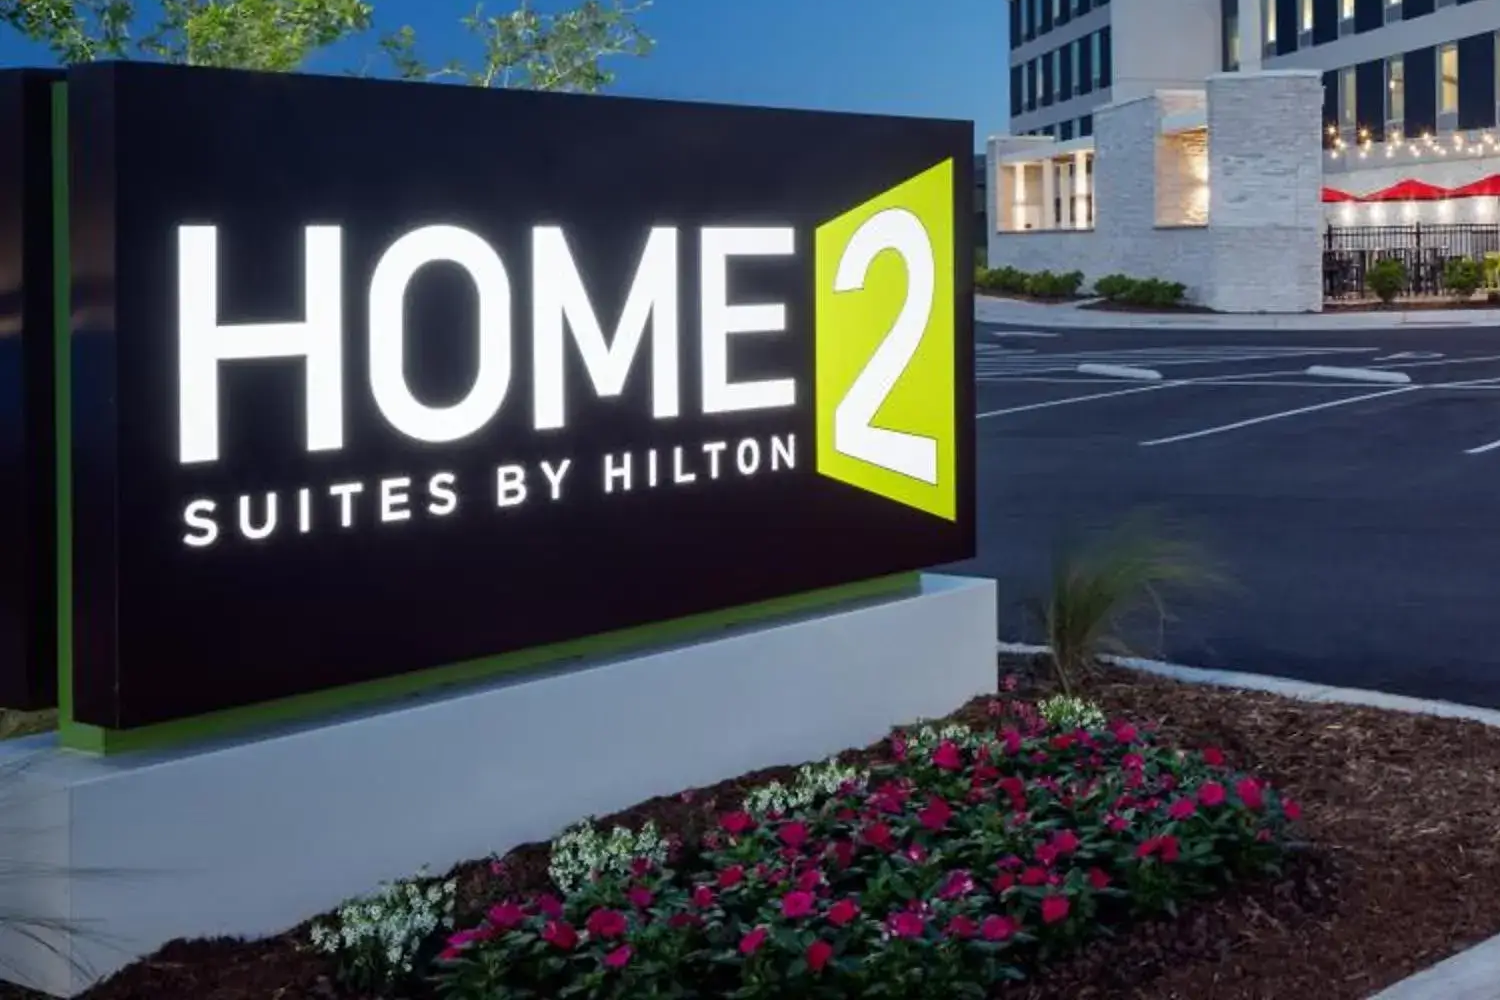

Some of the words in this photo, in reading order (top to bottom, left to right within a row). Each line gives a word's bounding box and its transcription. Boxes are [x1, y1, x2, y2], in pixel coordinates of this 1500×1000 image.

[182, 472, 458, 548] SUITES
[496, 458, 572, 508] BY
[603, 432, 797, 494] HILTON
